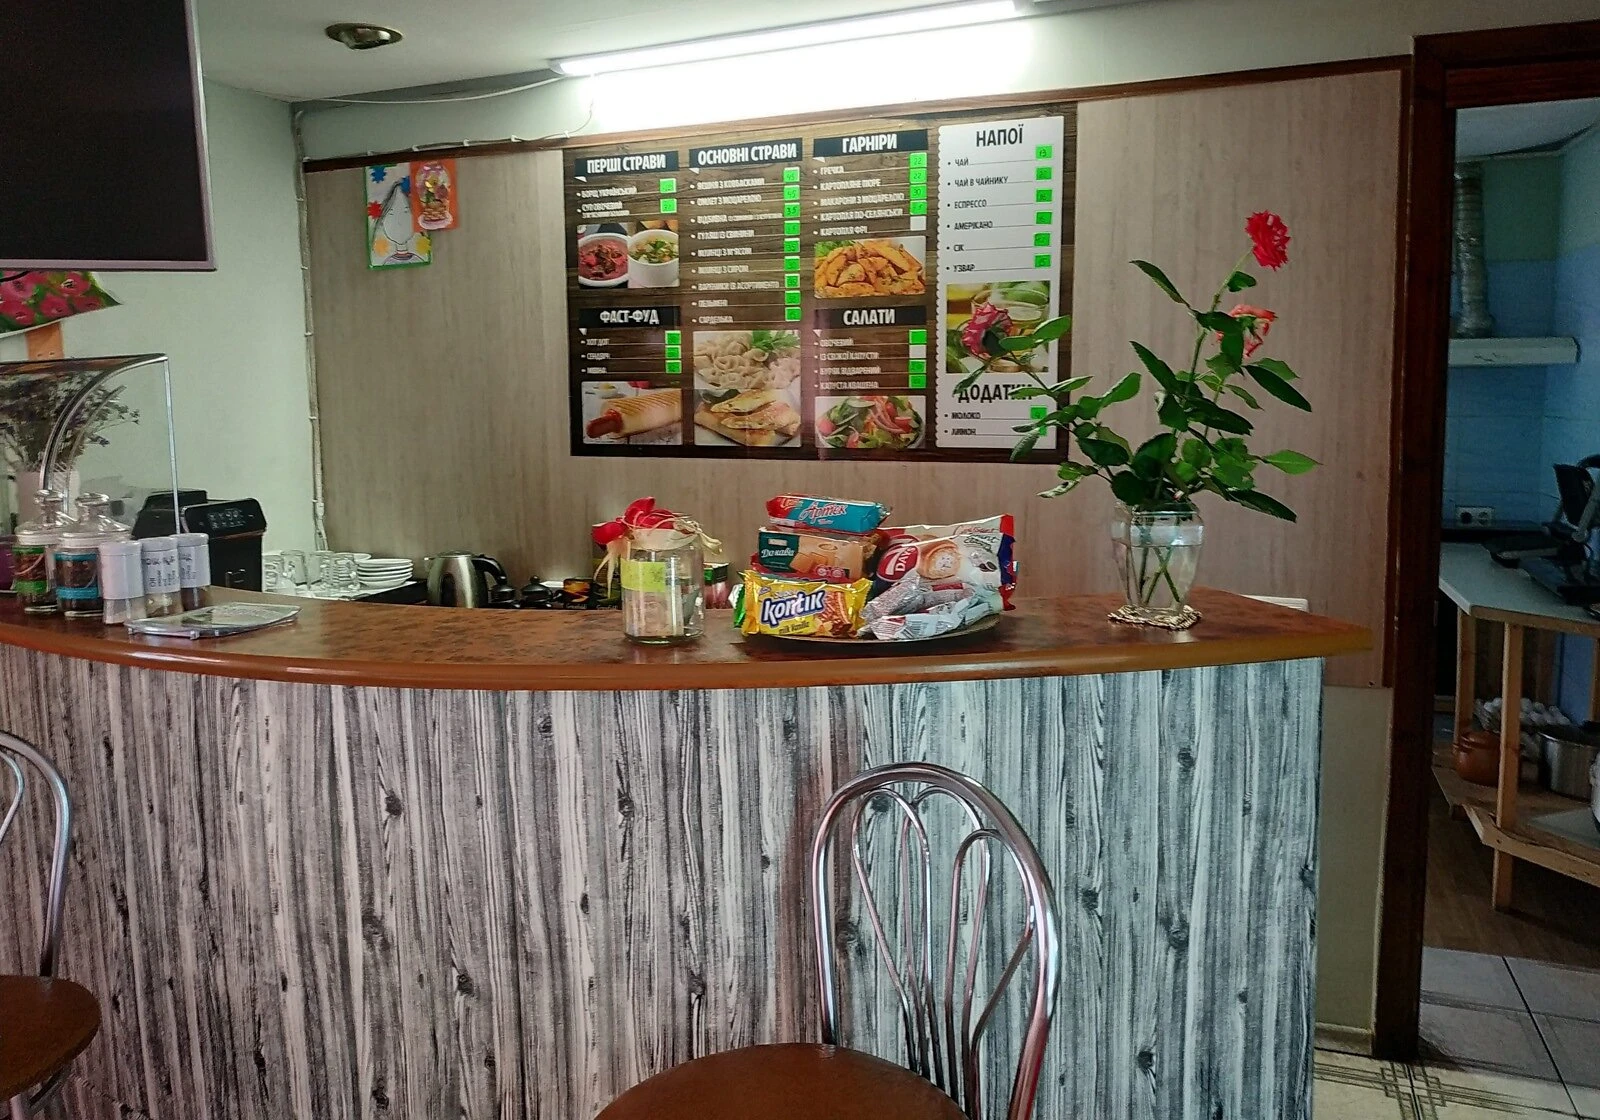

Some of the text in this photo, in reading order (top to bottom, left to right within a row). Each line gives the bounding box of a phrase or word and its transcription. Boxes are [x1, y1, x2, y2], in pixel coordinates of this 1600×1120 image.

[976, 124, 1024, 147] НАПОЇ
[842, 133, 898, 153] ГАРНІРИ
[697, 143, 798, 165] ОСНОВНІ СТРАВИ
[586, 154, 666, 174] ПЕРШІ СТРАВИ
[955, 157, 969, 167] ЧАЙ
[820, 166, 844, 175] ГРЕЧКА
[820, 178, 881, 191] КАРТОПЛЯНЕ ПЮРЕ
[954, 176, 1009, 187] ЧАЙ В ЧАЙНИКУ
[581, 190, 599, 198] БОРЩ
[787, 190, 796, 199] 45
[820, 193, 905, 206] МАКАРОНИ З МОЦАРЕЛОЮ
[954, 199, 987, 209] ЕСПРЕССО
[787, 206, 797, 215] 35
[820, 211, 853, 222] КАРТОПЛЯ
[820, 226, 868, 237] КАРТОПЛЯ ФРІ
[953, 244, 965, 252] СІК
[953, 263, 976, 273] УЗВАР
[600, 309, 660, 324] ФАСТ-ФУД
[843, 309, 895, 325] САЛАТИ
[951, 412, 981, 420] МОЛОКО
[894, 546, 917, 572] DAYS
